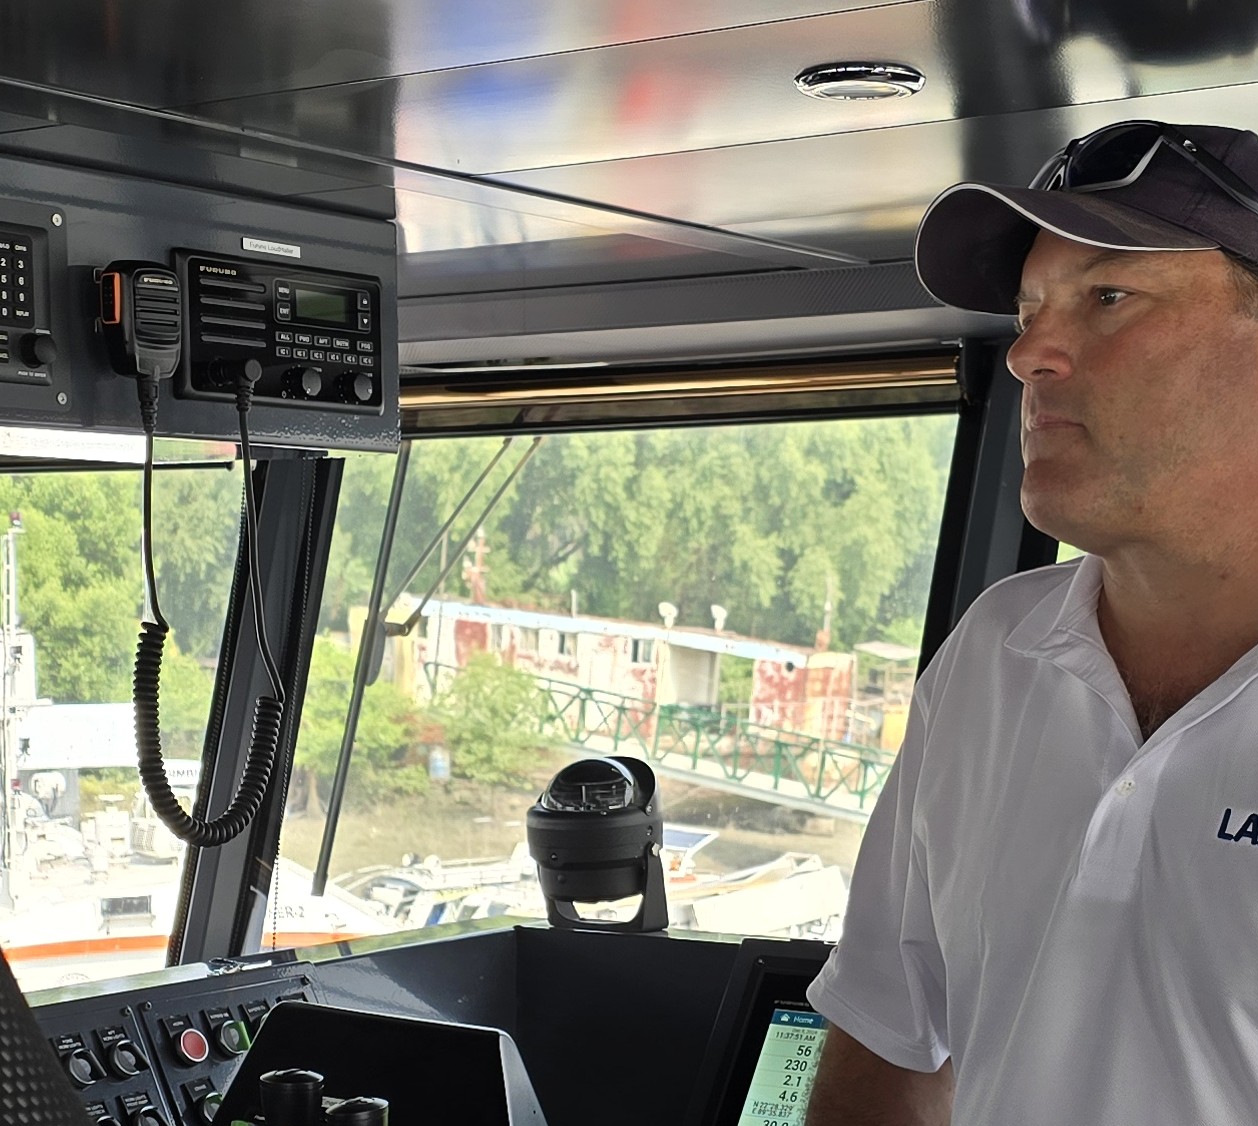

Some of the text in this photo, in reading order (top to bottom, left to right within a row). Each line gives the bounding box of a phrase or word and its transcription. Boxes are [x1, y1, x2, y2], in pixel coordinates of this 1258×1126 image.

[794, 1016, 814, 1024] Home
[796, 1045, 812, 1056] 56
[784, 1060, 808, 1072] 230
[783, 1075, 802, 1087] 2.1
[779, 1090, 798, 1102] 4.6
